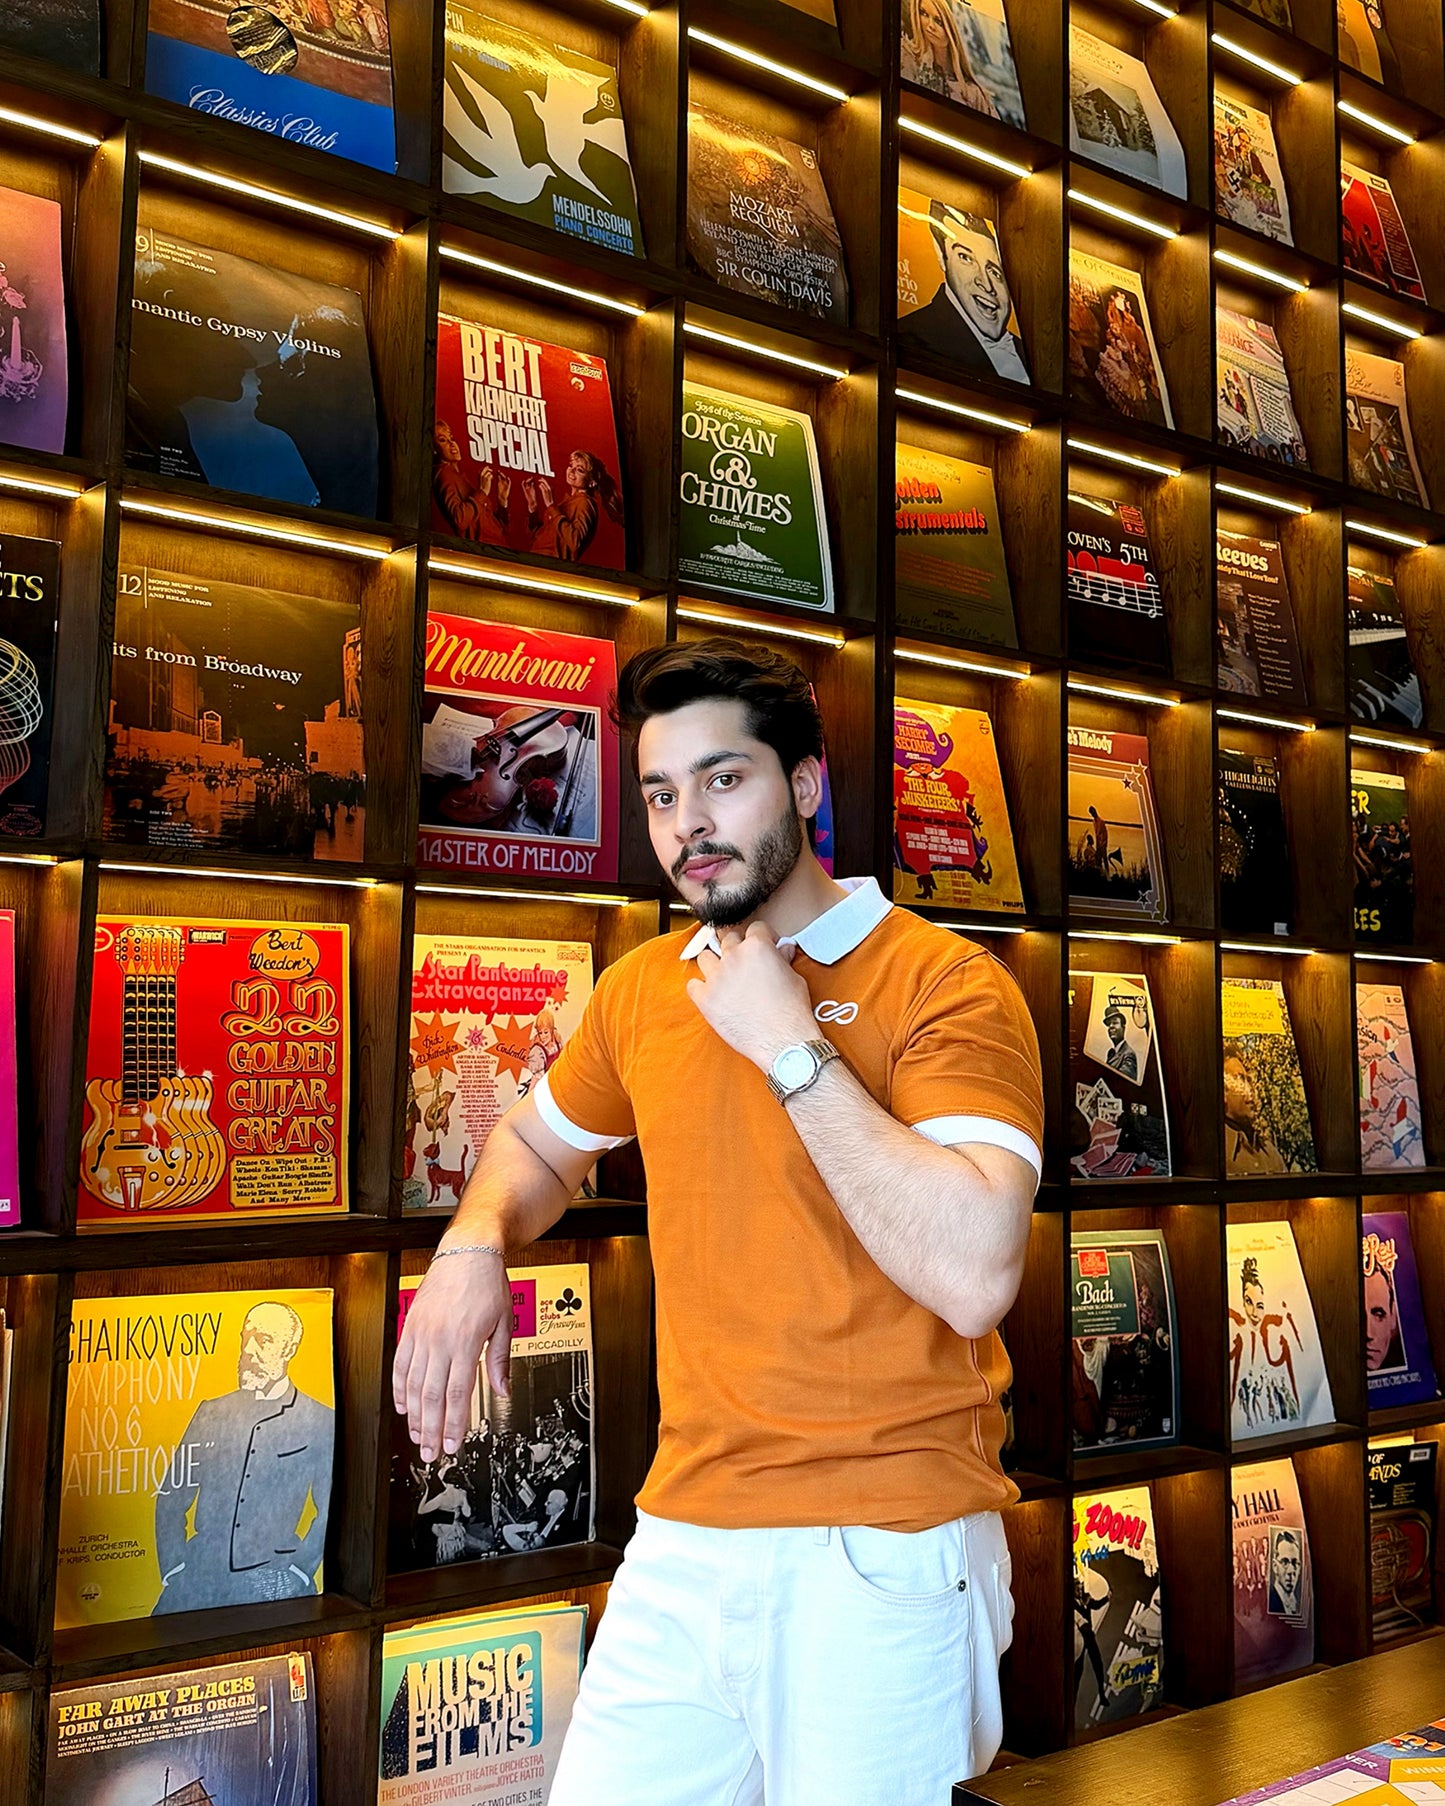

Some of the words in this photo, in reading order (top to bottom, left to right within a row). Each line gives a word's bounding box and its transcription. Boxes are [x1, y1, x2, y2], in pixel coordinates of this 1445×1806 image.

[445, 11, 464, 32] PIN
[189, 84, 279, 134] Classics
[281, 113, 338, 150] Club
[552, 194, 633, 238] MENDELSSOHN
[729, 190, 793, 223] MOZART
[729, 204, 800, 242] REQUIEM
[135, 235, 149, 253] 9
[554, 213, 583, 233] PIANO
[586, 223, 634, 251] CONCERTO
[716, 259, 739, 278] SIR
[742, 266, 787, 293] COLIN
[790, 281, 833, 308] DAVIS
[131, 298, 203, 327] mantic
[207, 317, 267, 344] Gypsy
[272, 330, 341, 357] Violins
[460, 324, 542, 398] BERT
[464, 380, 547, 432] KAEMPFERT
[467, 415, 555, 478] SPECIAL
[682, 412, 778, 458] ORGAN
[709, 449, 757, 489] &
[681, 471, 792, 525] CHIMES
[896, 477, 940, 500] olden
[709, 514, 747, 531] Christmas
[745, 521, 767, 534] Time
[896, 507, 987, 533] strumentals
[1068, 531, 1111, 554] OVEN'S
[1120, 543, 1149, 566] 5TH
[1217, 542, 1269, 572] Reeves
[0, 571, 44, 602] TS
[119, 573, 142, 596] 12
[148, 578, 170, 586] MOOD
[171, 581, 194, 590] MUSIC
[195, 585, 209, 593] FOR
[148, 586, 187, 596] LISTENING
[148, 592, 165, 600] AND
[166, 594, 212, 607] RELAXATION
[145, 646, 197, 667] from
[204, 654, 302, 686] Broadway
[425, 618, 596, 693] Mantovani
[895, 736, 937, 756] SECOMBE
[897, 724, 929, 740] HARRY
[1079, 732, 1113, 754] Melody
[901, 791, 962, 812] MUSKETEERS!
[904, 776, 926, 793] THE
[925, 779, 952, 797] FOUR
[493, 844, 520, 869] OF
[522, 846, 597, 875] MELODY
[268, 929, 304, 950] Bert
[249, 952, 314, 977] Weedon's
[426, 951, 466, 980] Star
[470, 953, 568, 984] Pantomime
[412, 972, 548, 1011] Extravaganza
[228, 1041, 336, 1076] GOLDEN
[227, 1078, 336, 1116] GUITAR
[227, 1115, 335, 1155] GREATS
[275, 1158, 293, 1166] Wipe
[269, 1196, 289, 1204] Many
[1076, 1280, 1114, 1305] Bach
[540, 1312, 561, 1320] clubs
[67, 1312, 222, 1364] CHAIKOVSKY
[528, 1338, 583, 1350] PICCADILLY
[69, 1356, 201, 1409] YMPHONY
[80, 1406, 120, 1450] NO.
[126, 1405, 142, 1448] 6
[1371, 1453, 1385, 1464] OF
[1243, 1489, 1285, 1517] HALL
[79, 1534, 109, 1544] ZURICH
[1085, 1502, 1147, 1550] ZOOM!
[91, 1540, 139, 1552] ORCHESTRA
[95, 1549, 146, 1562] CONDUCTOR
[406, 1643, 533, 1711] MUSIC
[58, 1701, 102, 1723] FAR
[108, 1689, 170, 1715] AWAY
[176, 1675, 256, 1702] PLACES
[409, 1700, 480, 1738] FROM
[487, 1688, 533, 1723] THE
[58, 1720, 100, 1739] JOHN
[102, 1712, 146, 1730] GART
[149, 1708, 168, 1722] AT
[172, 1703, 203, 1718] THE
[206, 1693, 256, 1712] ORGAN
[409, 1712, 533, 1776] FILMS
[381, 1788, 396, 1801] THE
[397, 1781, 430, 1797] LONDON
[432, 1772, 465, 1790] VARIETY
[466, 1764, 498, 1781] THEATRE
[499, 1754, 544, 1774] ORCHESTRA
[411, 1790, 444, 1806] GILBERT
[443, 1784, 472, 1800] VINTER
[495, 1773, 518, 1788] JOYCE
[519, 1766, 544, 1782] HATTO
[505, 1791, 528, 1805] CITIES
[530, 1788, 543, 1799] THE
